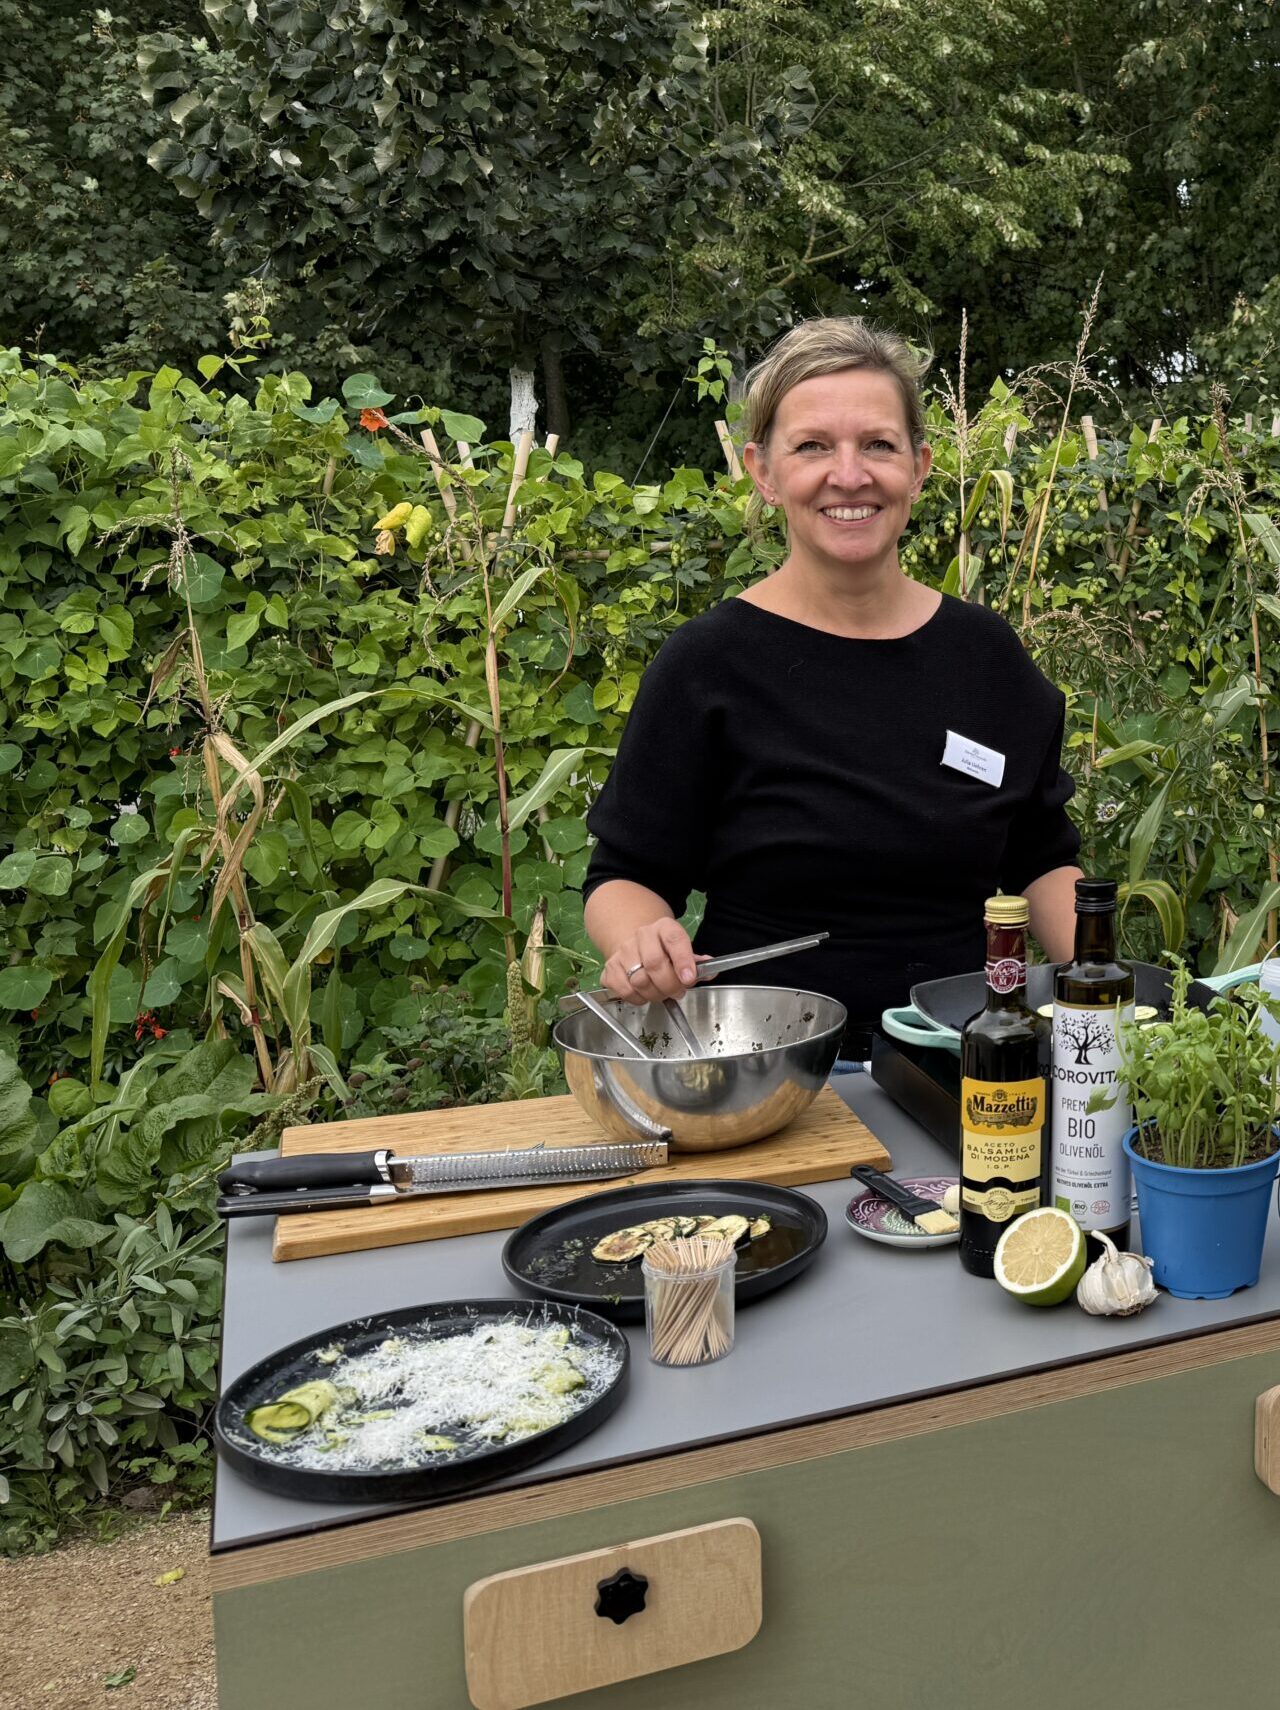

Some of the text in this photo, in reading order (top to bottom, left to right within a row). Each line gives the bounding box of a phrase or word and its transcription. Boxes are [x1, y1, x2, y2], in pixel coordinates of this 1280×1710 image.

[973, 1094, 1031, 1113] Mazzetti
[1061, 1097, 1089, 1111] PREM
[1068, 1117, 1096, 1139] BIO
[967, 1144, 1036, 1155] BALSAMICO
[1060, 1143, 1105, 1158] OLIVENÖL
[984, 1153, 1031, 1163] MODENA
